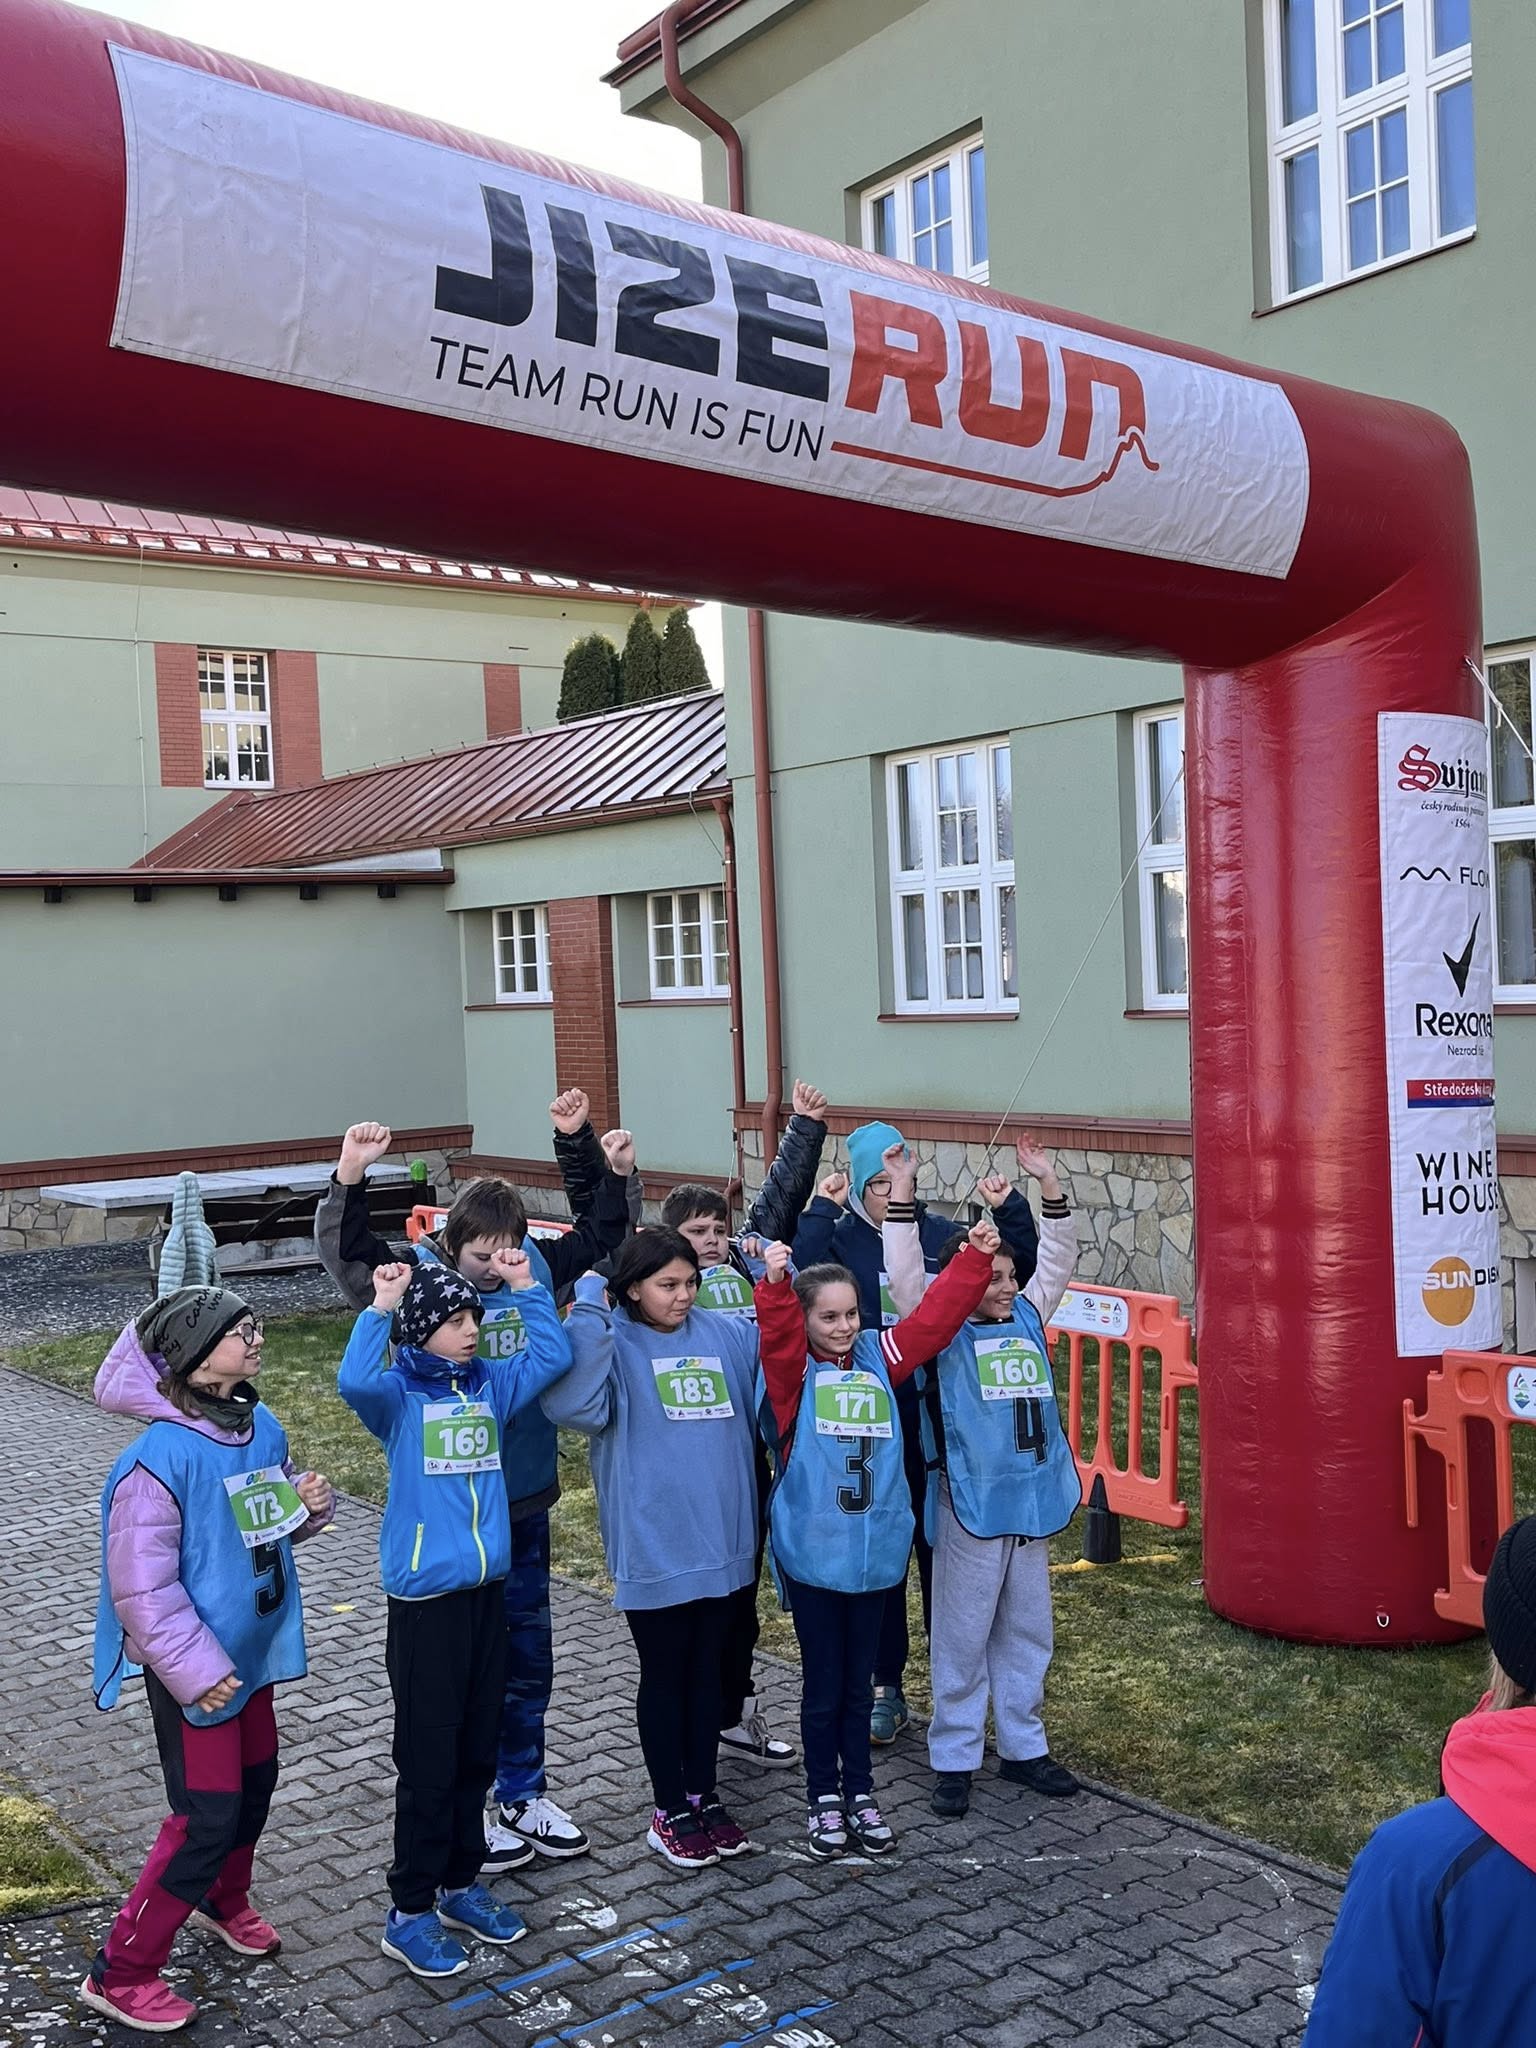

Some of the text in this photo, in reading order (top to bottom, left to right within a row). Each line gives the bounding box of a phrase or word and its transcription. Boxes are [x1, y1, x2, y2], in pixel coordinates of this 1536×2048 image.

[430, 336, 824, 462] TEAM RUN IS FUN
[1415, 1003, 1494, 1038] Rexona
[1416, 1150, 1492, 1182] WINE
[708, 1281, 743, 1305] 111
[990, 1358, 1038, 1385] 160
[670, 1377, 717, 1403] 183
[835, 1391, 876, 1419] 171
[439, 1425, 489, 1457] 169
[1013, 1396, 1049, 1466] 4
[836, 1434, 875, 1515] 3
[244, 1491, 284, 1526] 173
